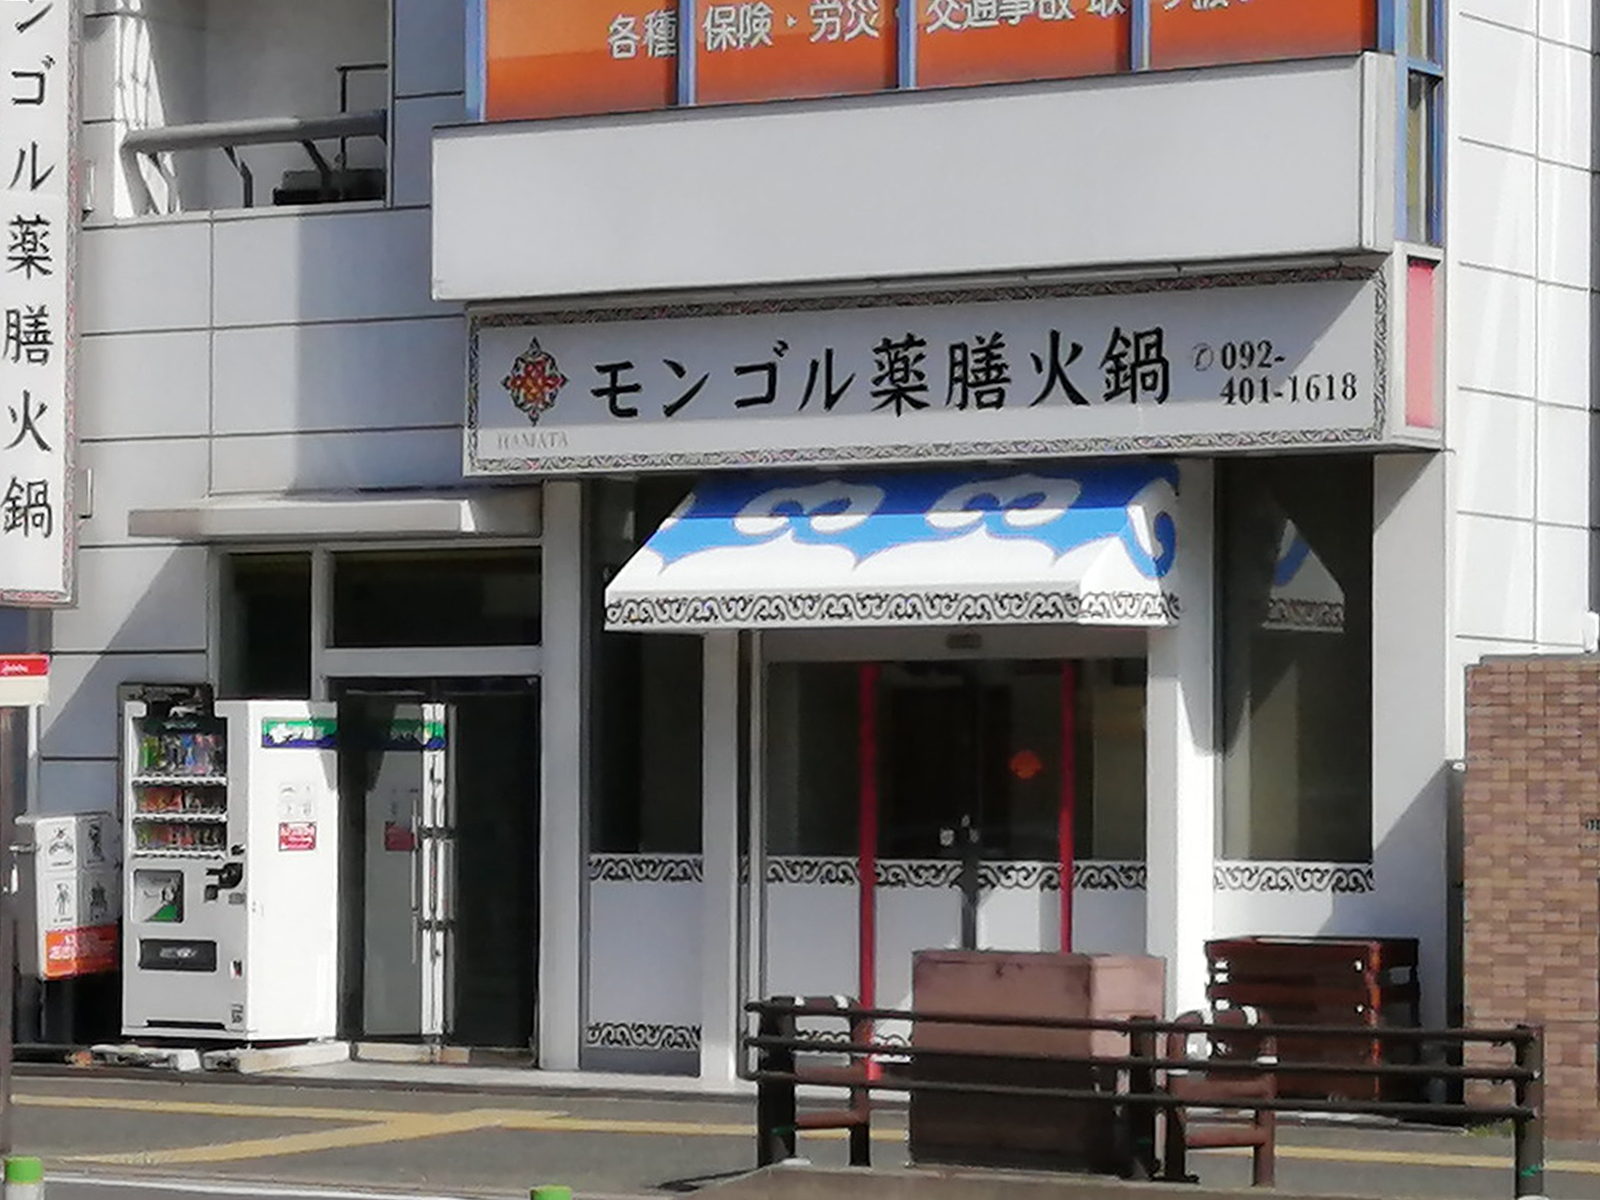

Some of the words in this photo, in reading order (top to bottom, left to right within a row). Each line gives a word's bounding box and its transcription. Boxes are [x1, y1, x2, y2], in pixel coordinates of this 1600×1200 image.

[590, 326, 1170, 418] モンゴル薬膳火鍋
[1219, 371, 1358, 406] 401-1618
